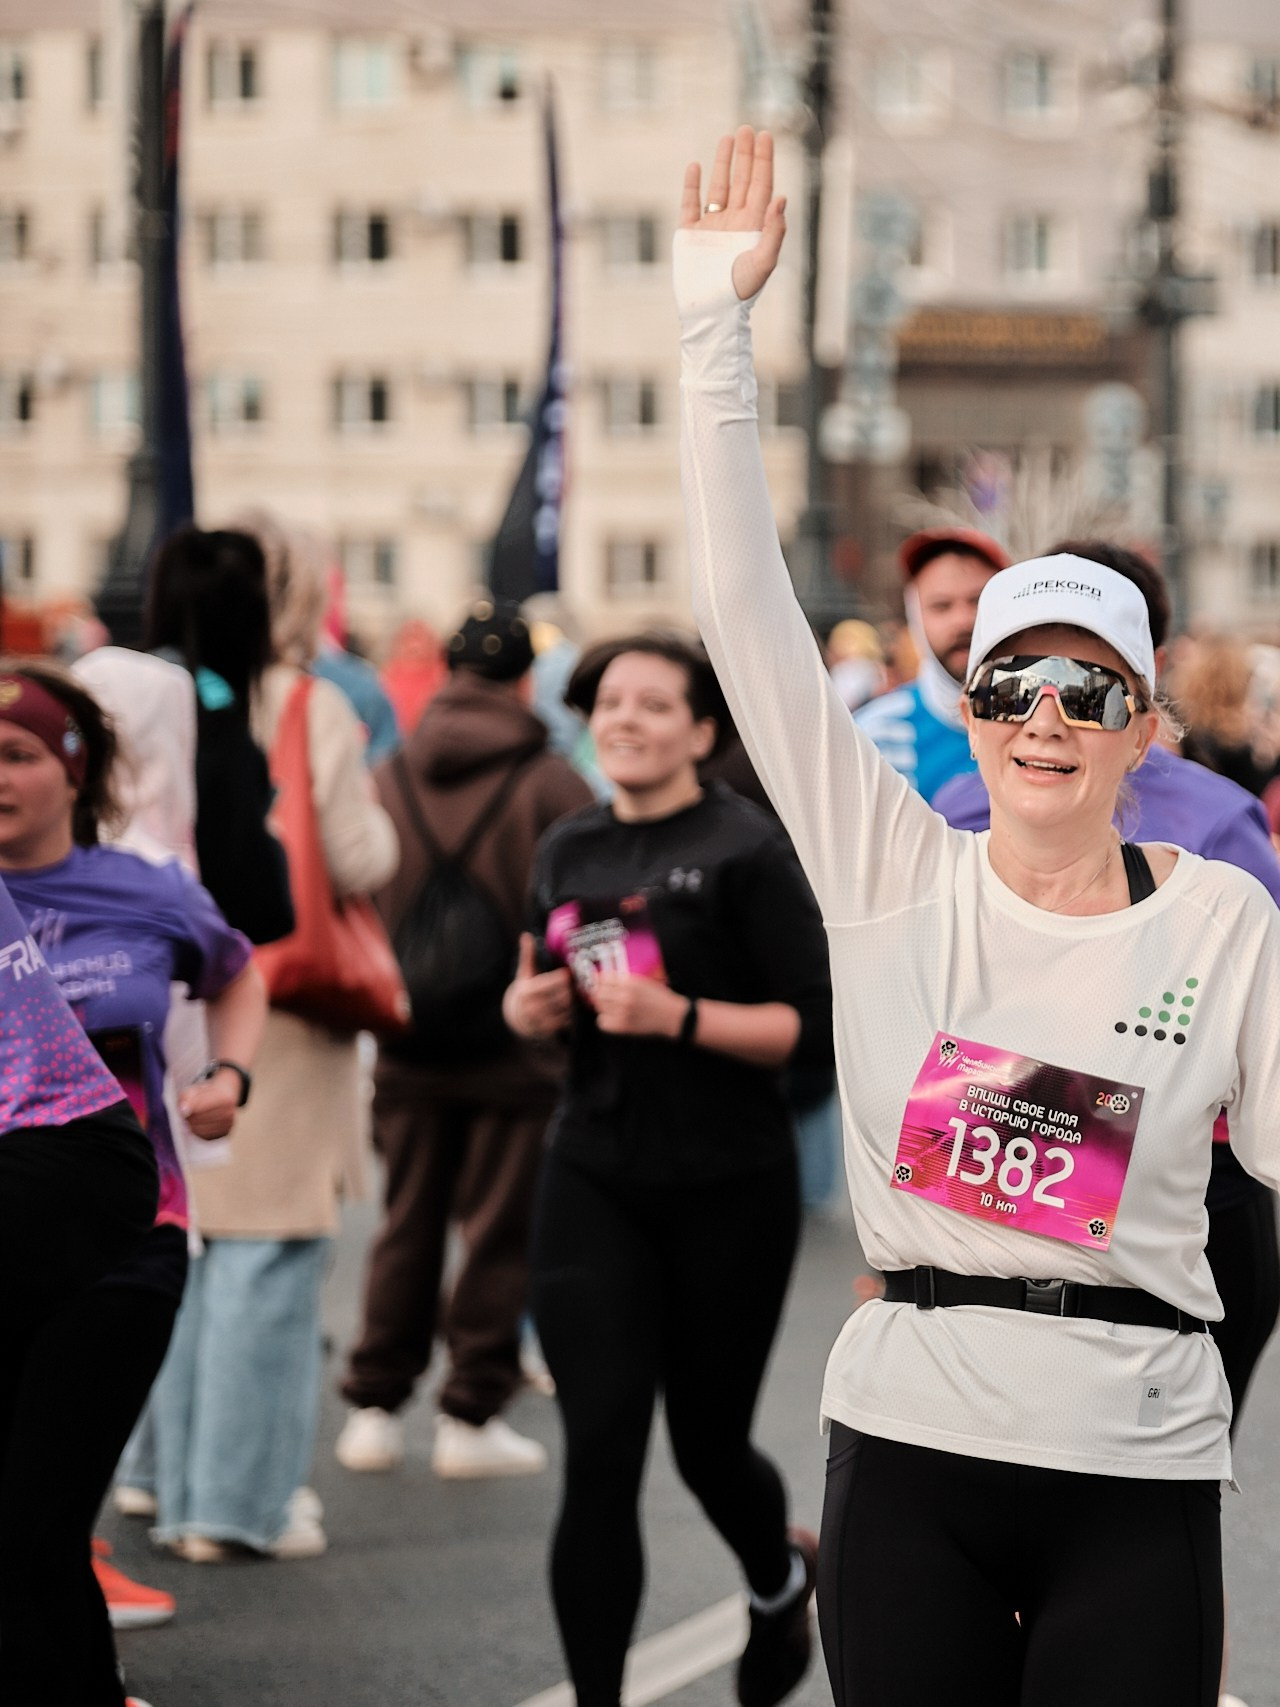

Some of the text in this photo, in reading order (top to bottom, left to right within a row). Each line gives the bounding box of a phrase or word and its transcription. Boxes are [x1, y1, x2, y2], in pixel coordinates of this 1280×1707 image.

[1033, 580, 1102, 597] РЕКОРД
[967, 1085, 1079, 1128] ВПИШИ СВОЕ ИМЯ
[1095, 1091, 1113, 1107] 20
[958, 1099, 1082, 1145] В ИСТОРИЮ ГОРОДА
[946, 1116, 1075, 1209] 1382
[980, 1191, 993, 1207] 10
